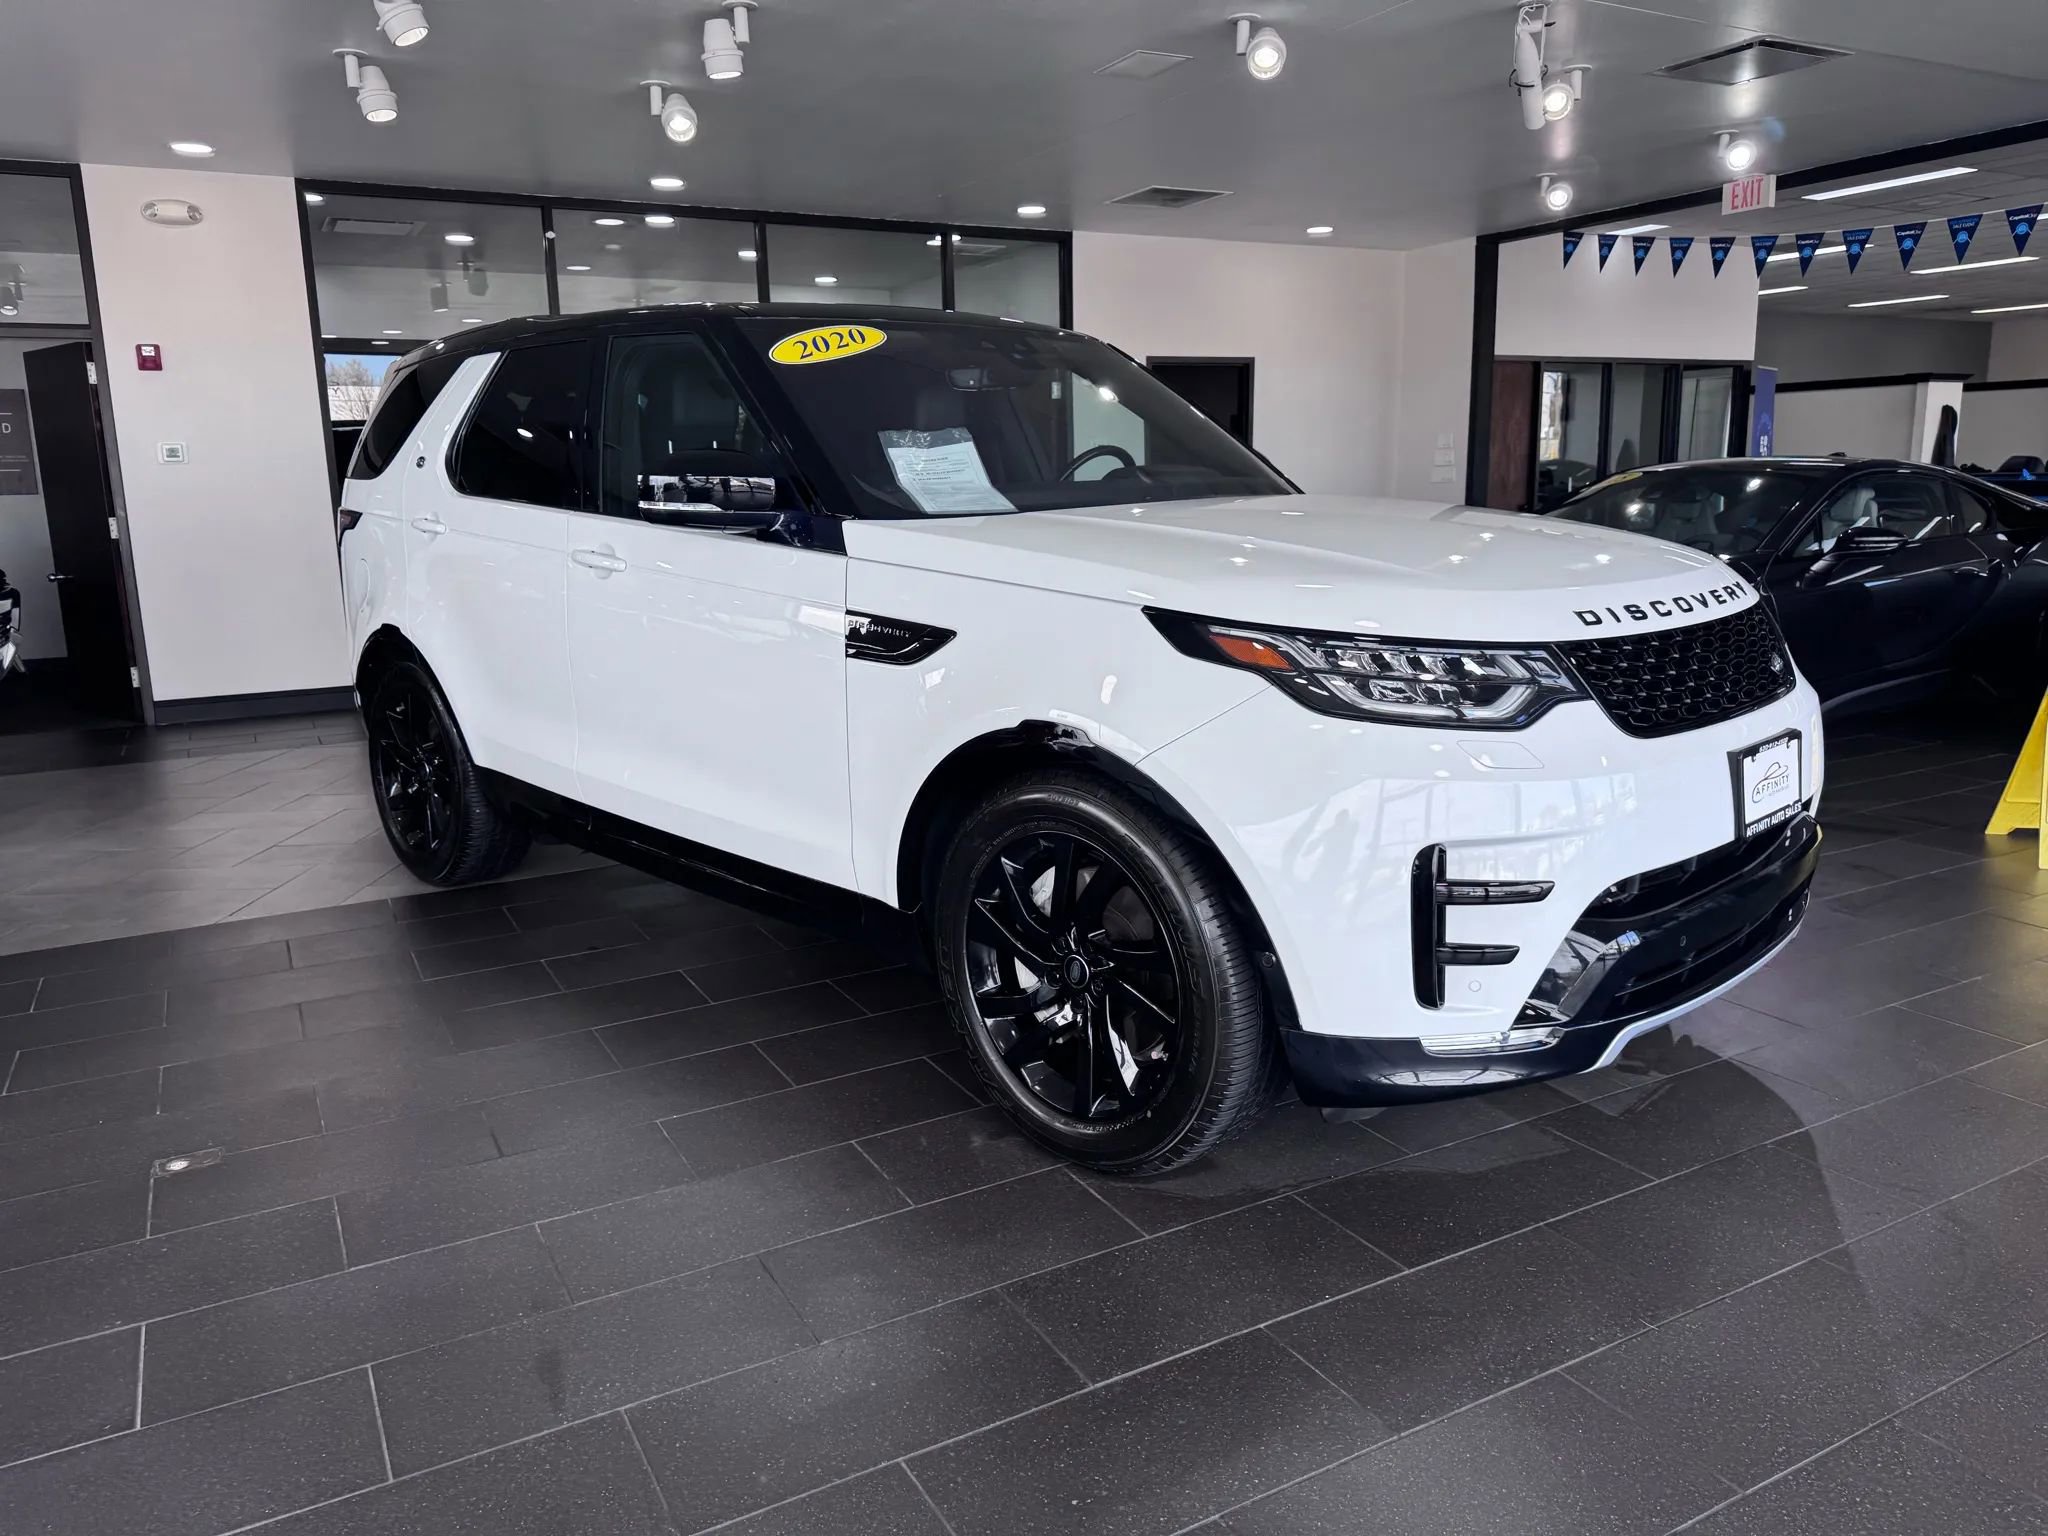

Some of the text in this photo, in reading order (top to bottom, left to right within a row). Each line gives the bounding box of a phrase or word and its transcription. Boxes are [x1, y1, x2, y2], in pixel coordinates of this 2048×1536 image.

[1731, 176, 1764, 210] EXIT
[792, 328, 866, 360] 2020
[1573, 581, 1748, 626] DISCOVERY
[1755, 774, 1790, 796] AFFINITY
[1746, 801, 1802, 838] AFFINITY AUTO SALES
